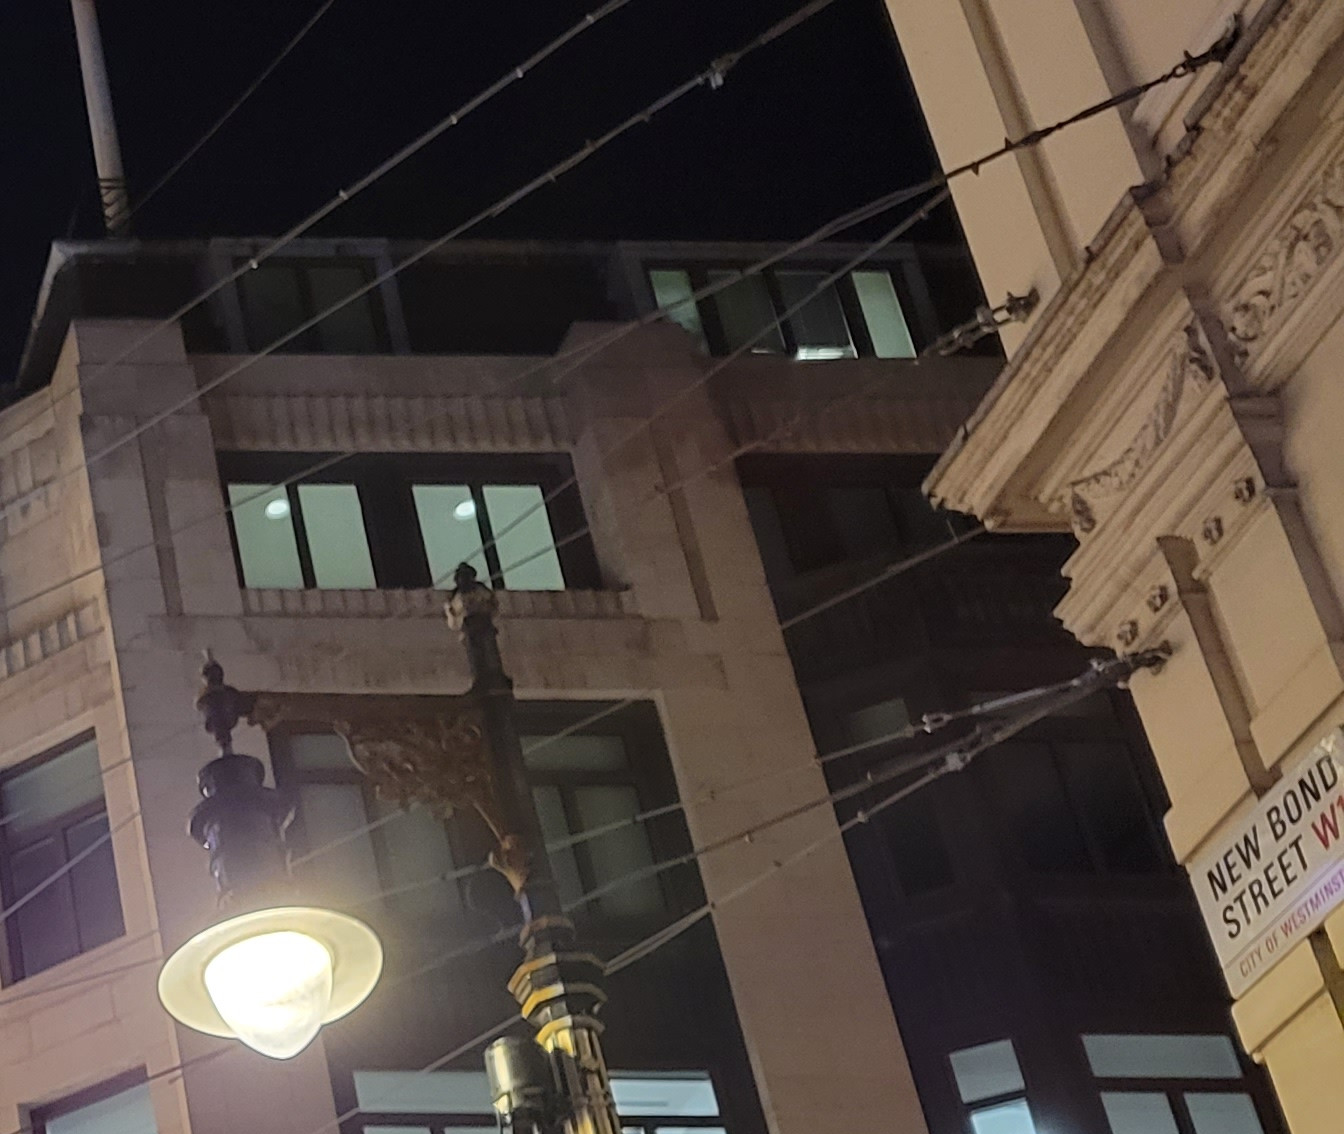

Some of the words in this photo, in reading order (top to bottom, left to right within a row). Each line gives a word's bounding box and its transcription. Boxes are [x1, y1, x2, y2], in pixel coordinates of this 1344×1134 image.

[1206, 824, 1262, 902] NEW
[1266, 754, 1339, 840] BOND
[1222, 834, 1309, 940] STREET
[1239, 948, 1263, 978] CITY
[1265, 930, 1279, 954] OF
